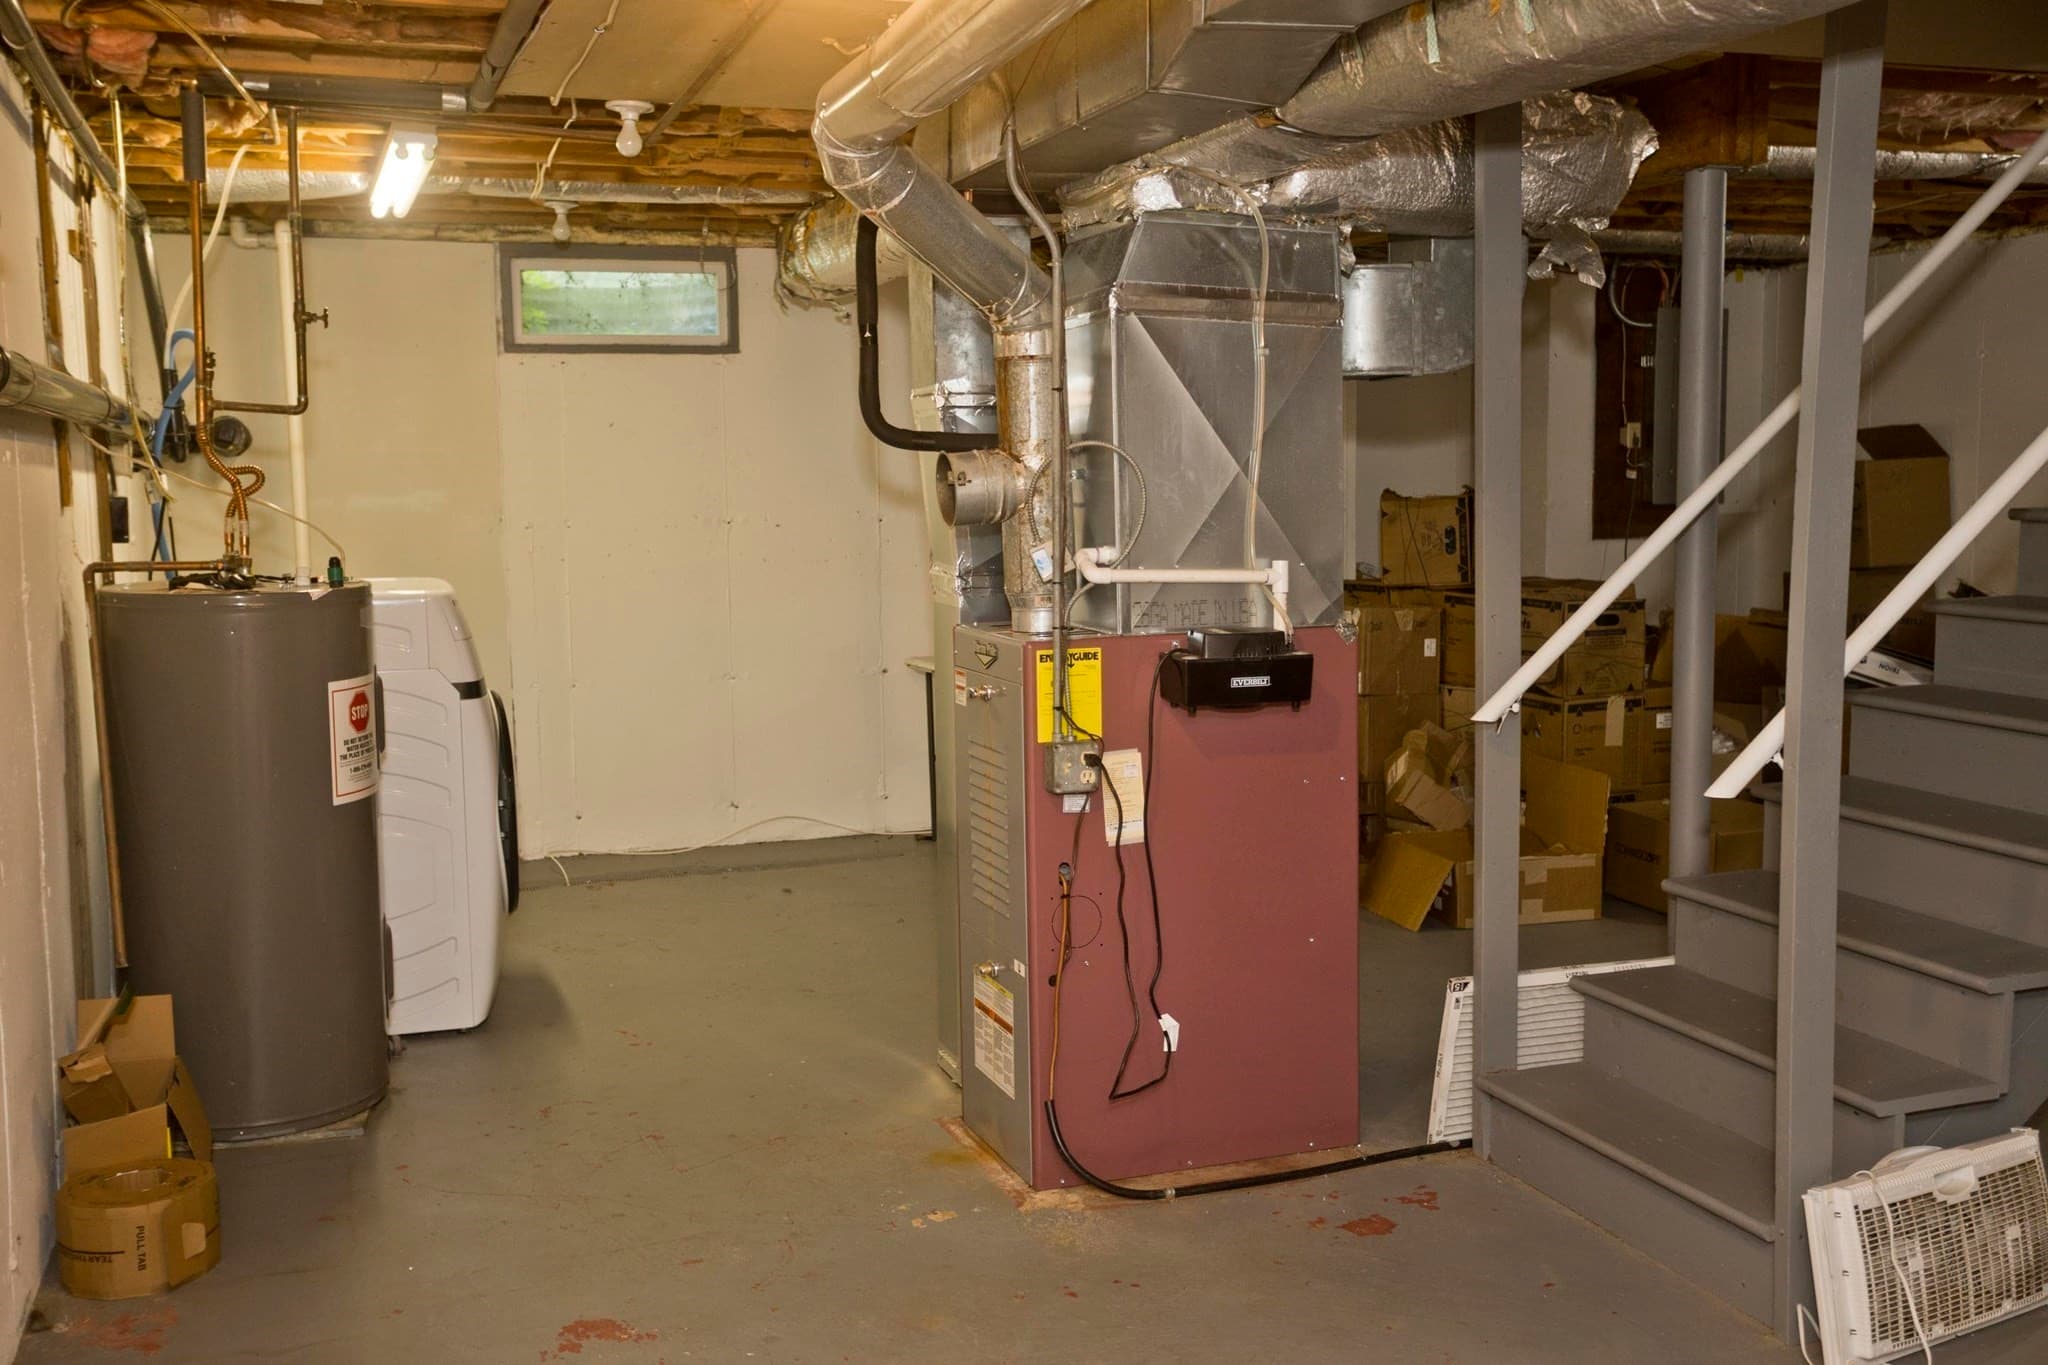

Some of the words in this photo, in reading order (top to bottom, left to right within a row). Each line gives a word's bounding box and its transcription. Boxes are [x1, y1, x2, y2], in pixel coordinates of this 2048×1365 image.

[352, 704, 368, 721] STOP
[136, 1225, 145, 1250] PULL
[136, 1252, 146, 1272] TAB
